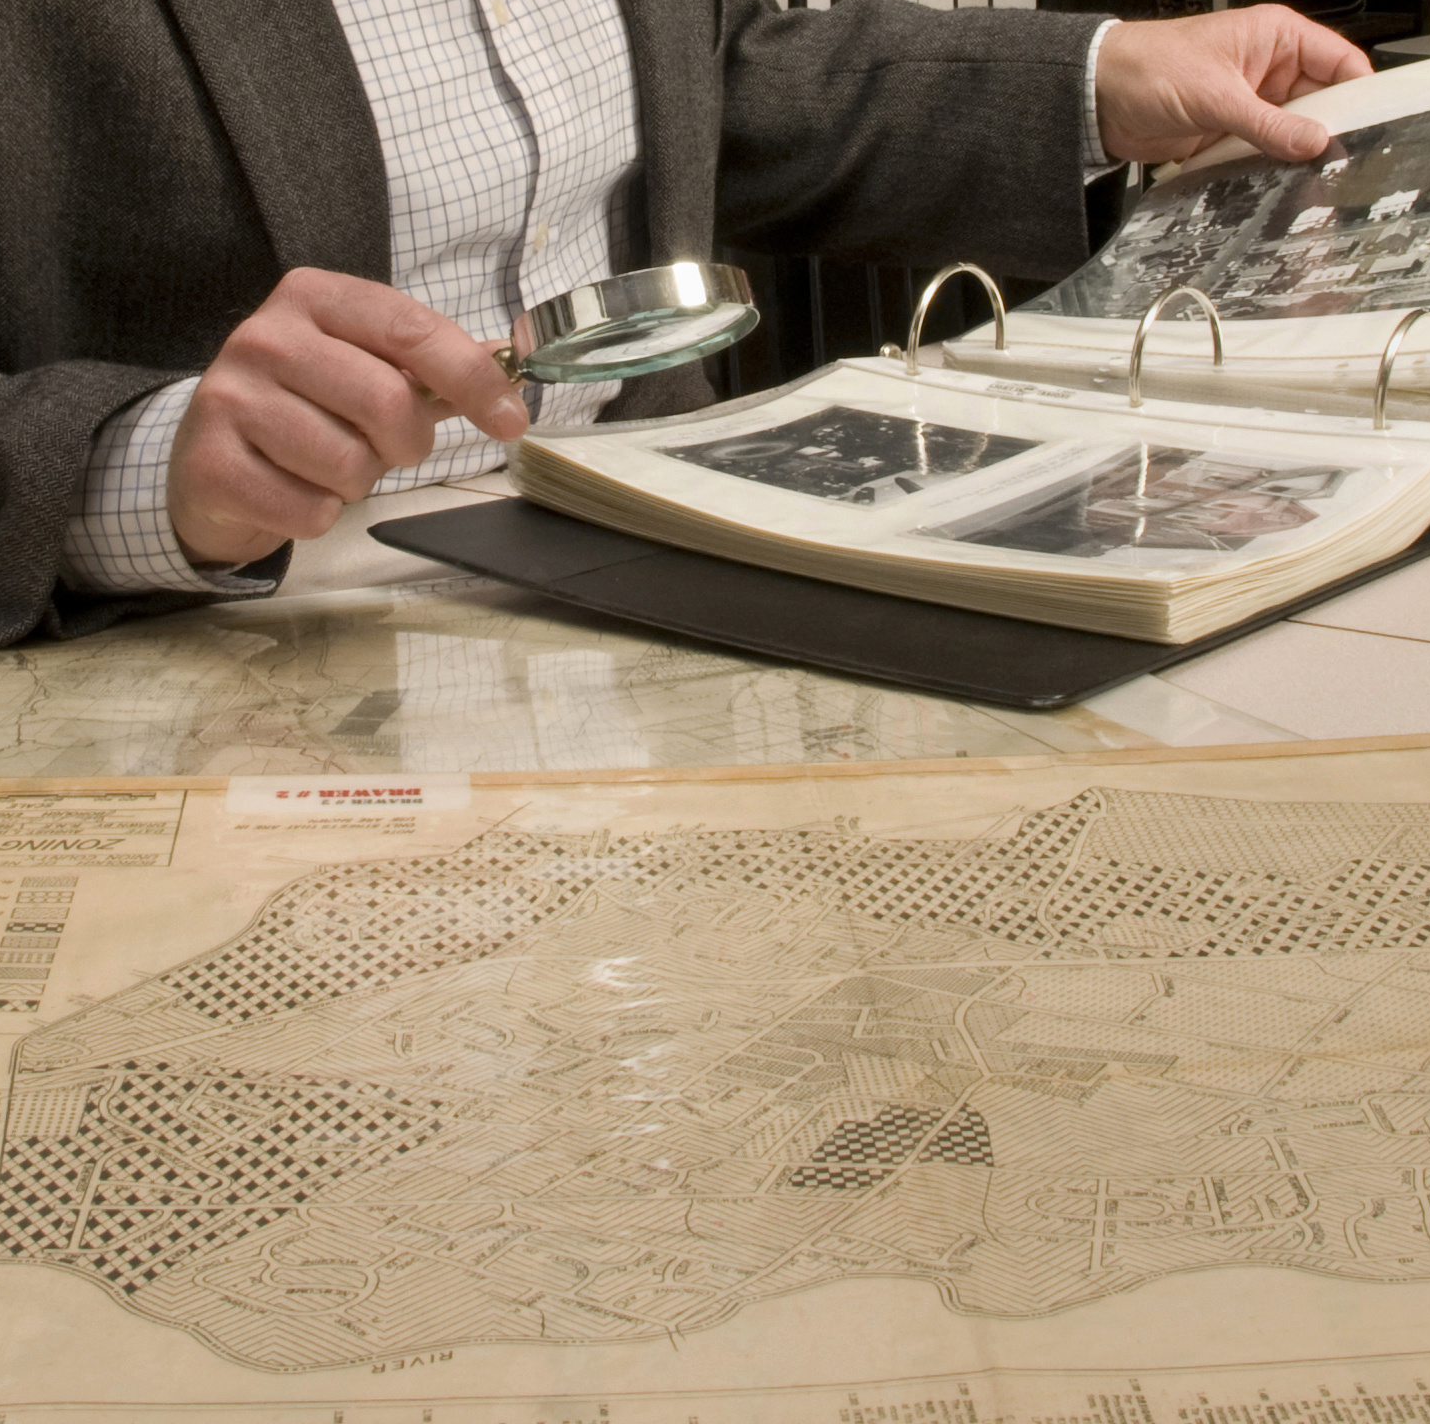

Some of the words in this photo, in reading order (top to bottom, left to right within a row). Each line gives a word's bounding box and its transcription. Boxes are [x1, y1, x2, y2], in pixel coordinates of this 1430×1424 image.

[275, 790, 290, 799] 2
[318, 788, 422, 798] DRAWER
[6, 802, 55, 810] SCALE
[0, 838, 125, 851] ZONING
[76, 859, 156, 867] BOROUGH
[369, 1349, 455, 1376] RIVER
